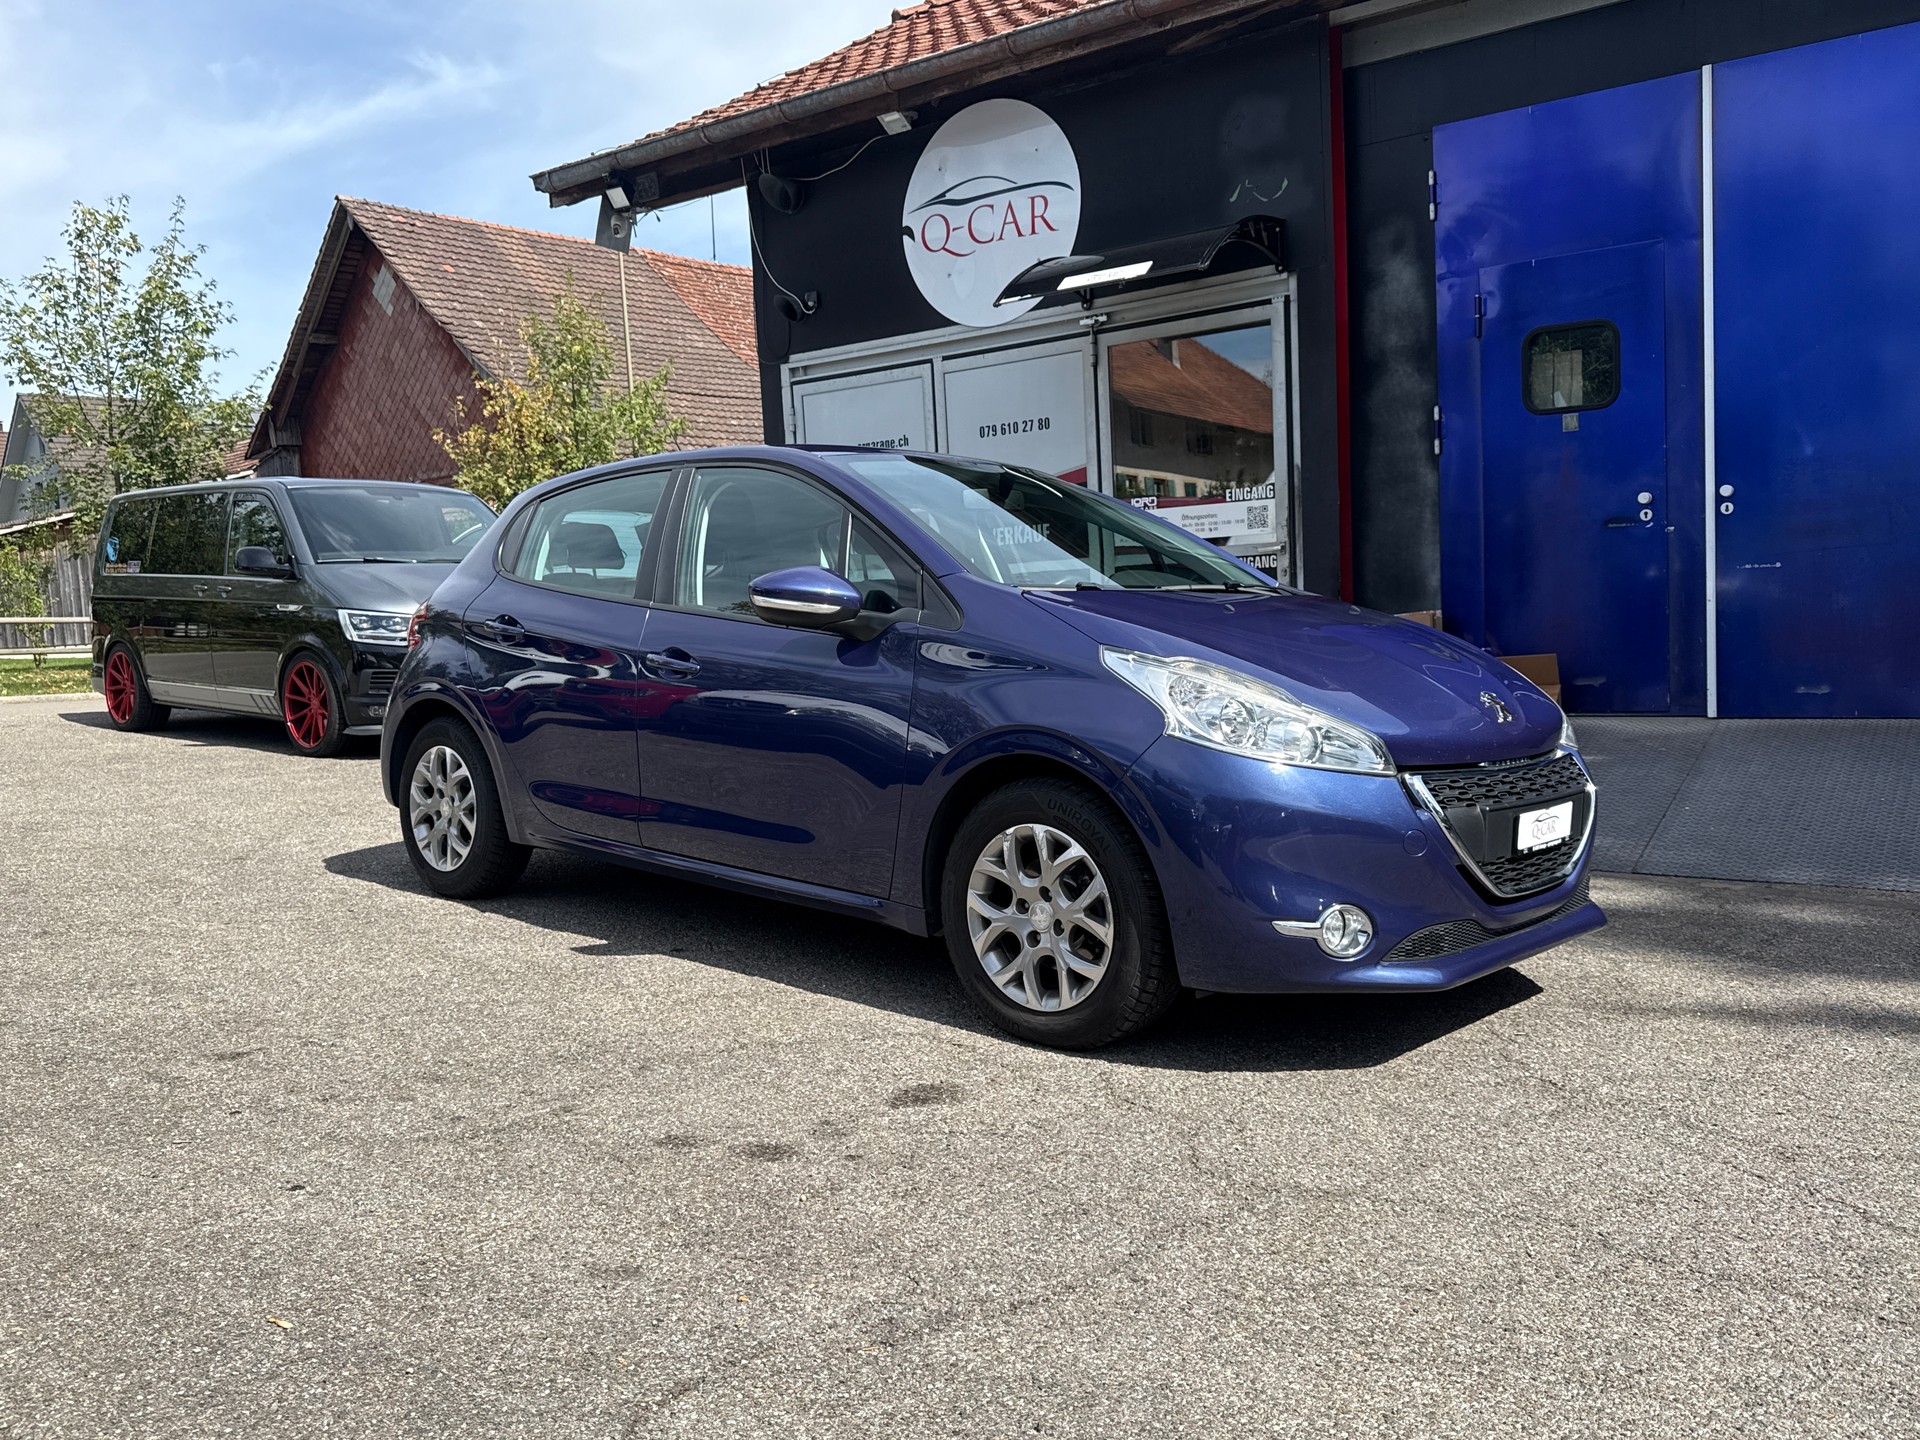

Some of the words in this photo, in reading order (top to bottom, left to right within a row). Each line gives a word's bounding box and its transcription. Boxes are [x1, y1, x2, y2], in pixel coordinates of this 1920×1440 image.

[920, 194, 1060, 257] Q-CAR
[979, 424, 998, 439] 079
[1000, 421, 1019, 436] 610
[1022, 419, 1034, 433] 27
[1037, 417, 1050, 431] 80
[1225, 485, 1274, 502] EINGANG
[1046, 797, 1111, 856] UNIROYAL
